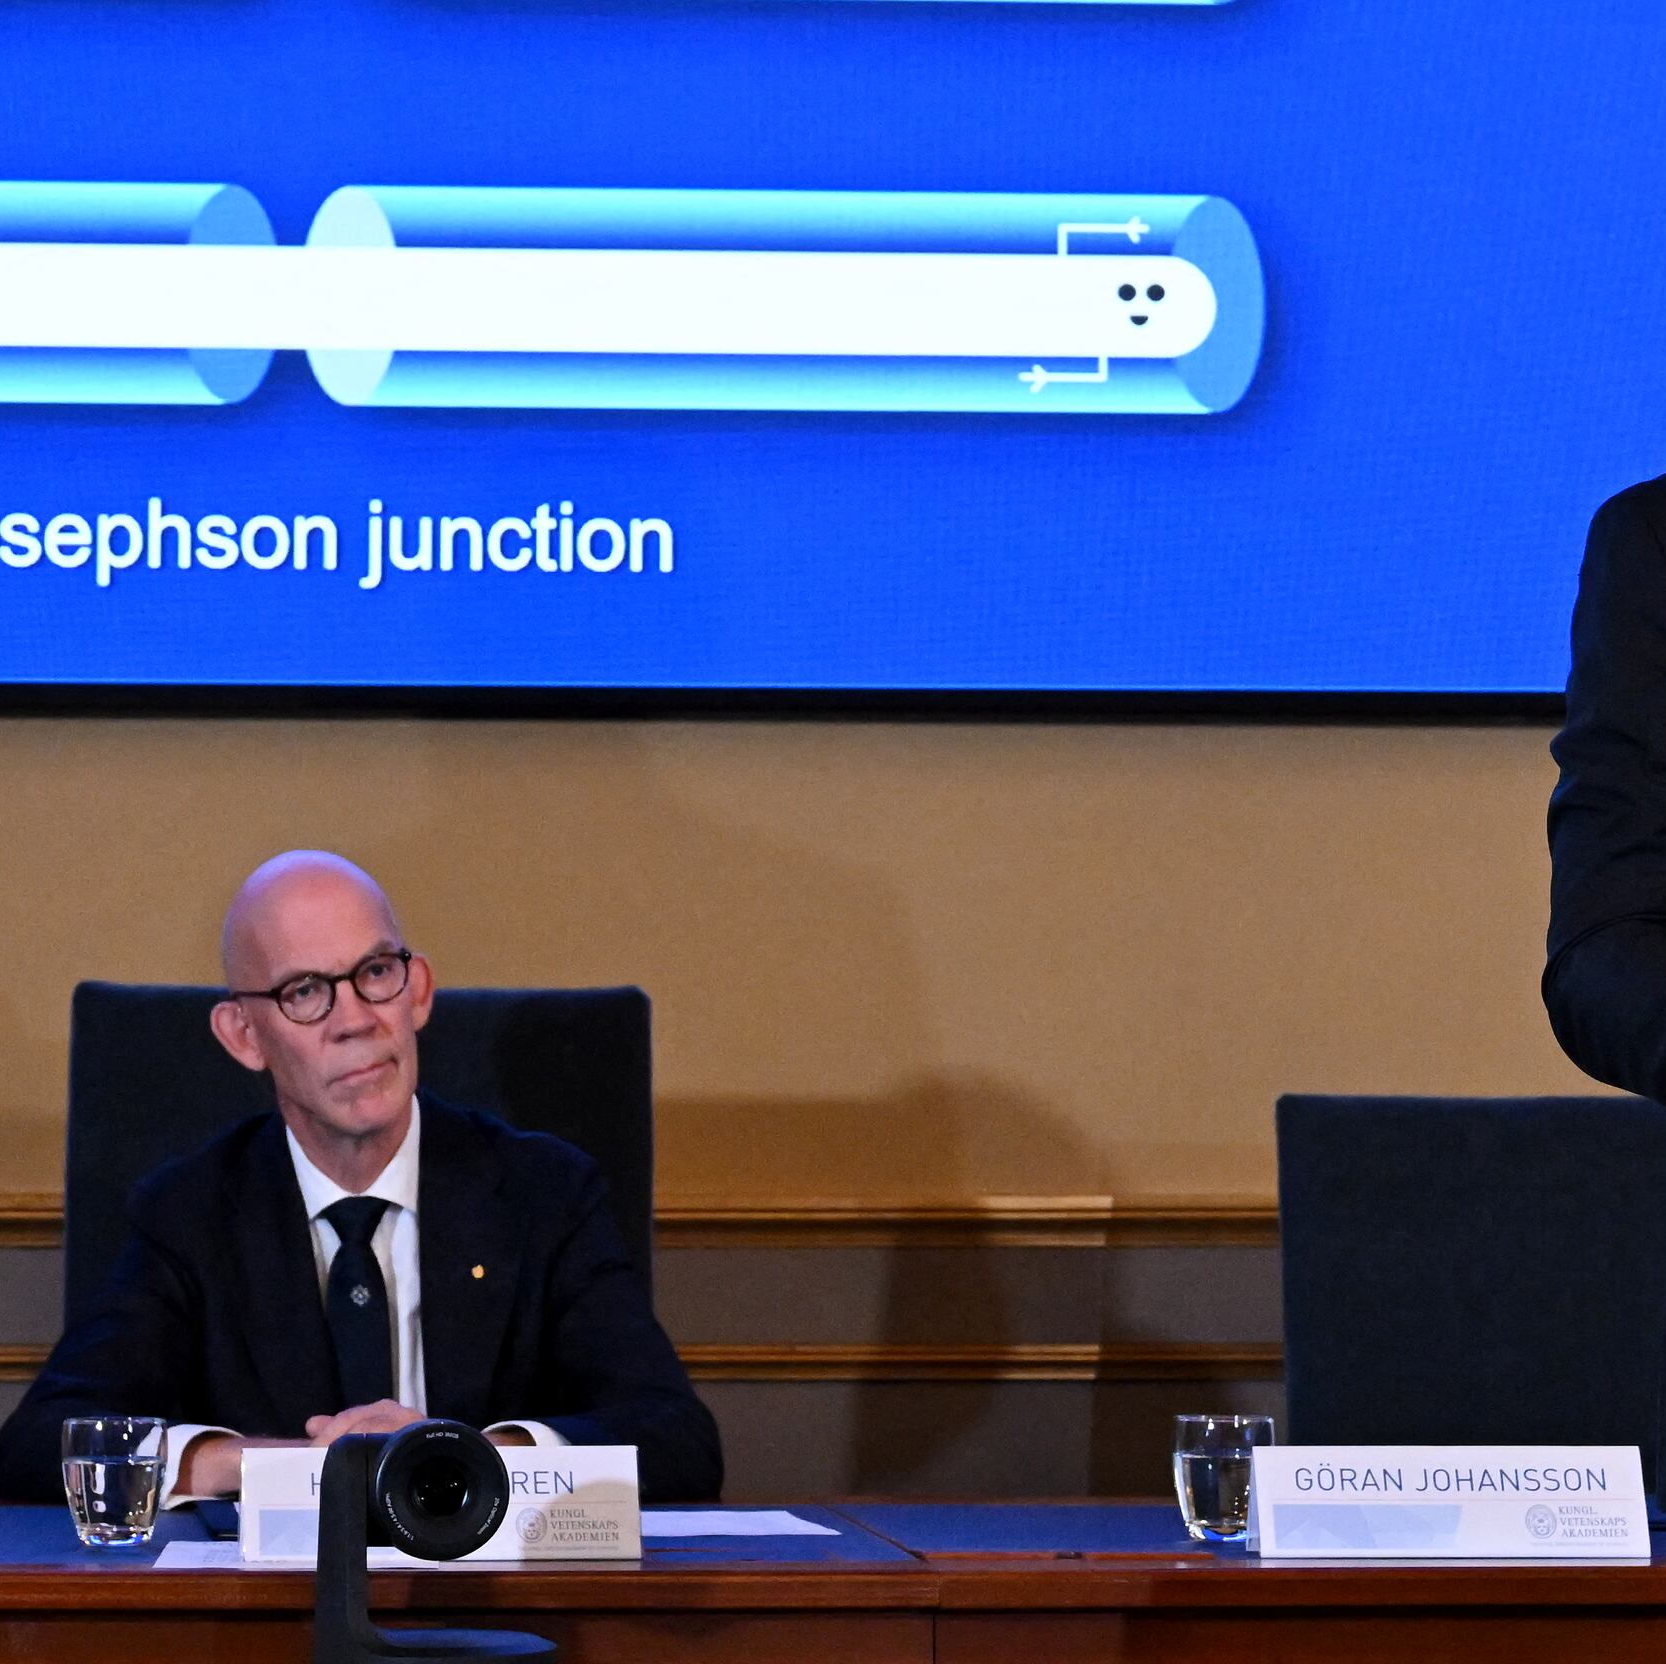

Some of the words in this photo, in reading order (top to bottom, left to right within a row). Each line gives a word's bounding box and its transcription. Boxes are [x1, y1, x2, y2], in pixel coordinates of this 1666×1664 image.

[357, 497, 675, 591] junction
[1294, 1462, 1403, 1492] GÖRAN
[1415, 1467, 1607, 1493] JOHANSSON
[551, 1531, 621, 1542] AKADEMIEN
[1560, 1527, 1629, 1538] AKADEMIEN
